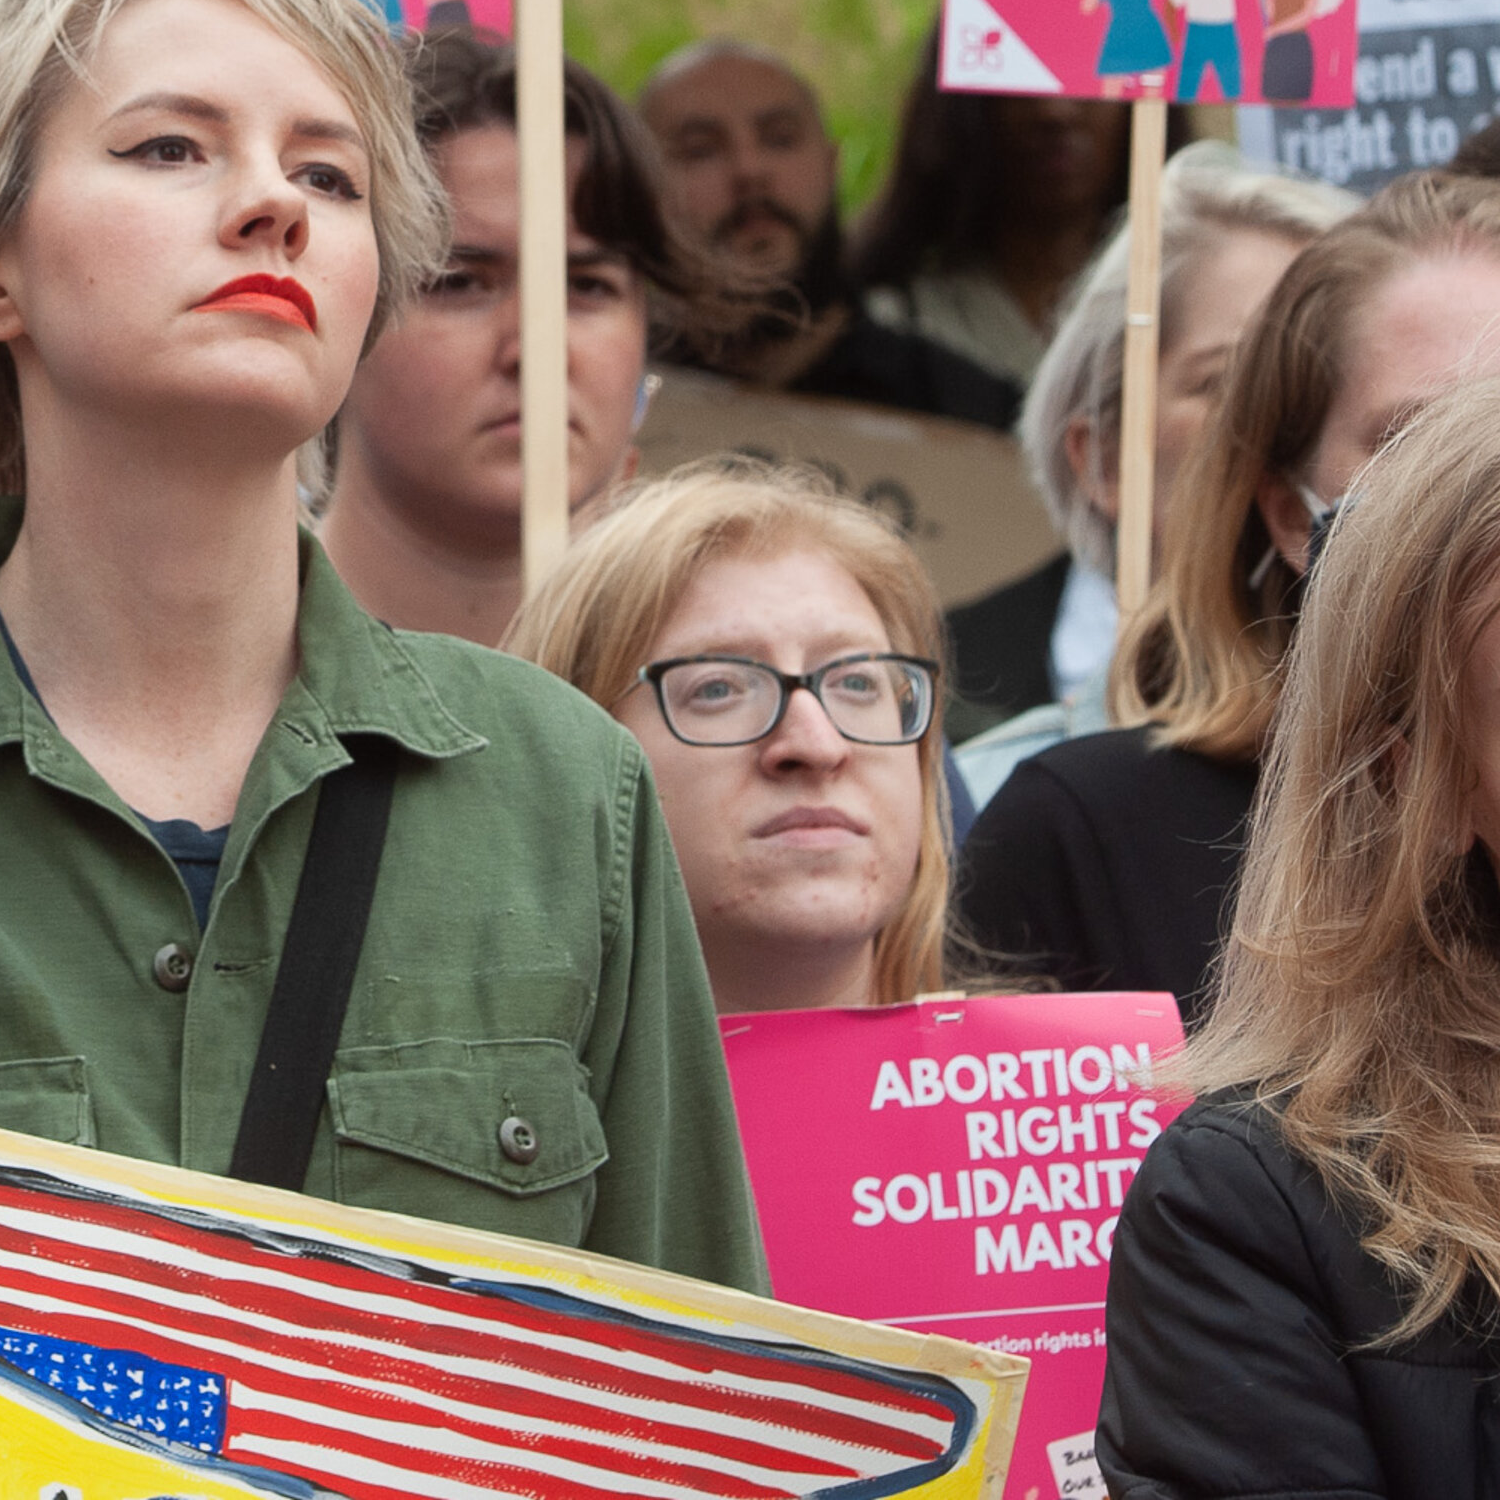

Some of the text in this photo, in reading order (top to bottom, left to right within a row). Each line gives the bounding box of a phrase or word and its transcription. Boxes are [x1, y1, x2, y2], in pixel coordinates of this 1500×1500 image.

[869, 1043, 1153, 1111] ABORTION
[965, 1100, 1161, 1160] RIGHTS
[851, 1158, 1142, 1227] SOLIDARIT
[1034, 1331, 1091, 1355] rights
